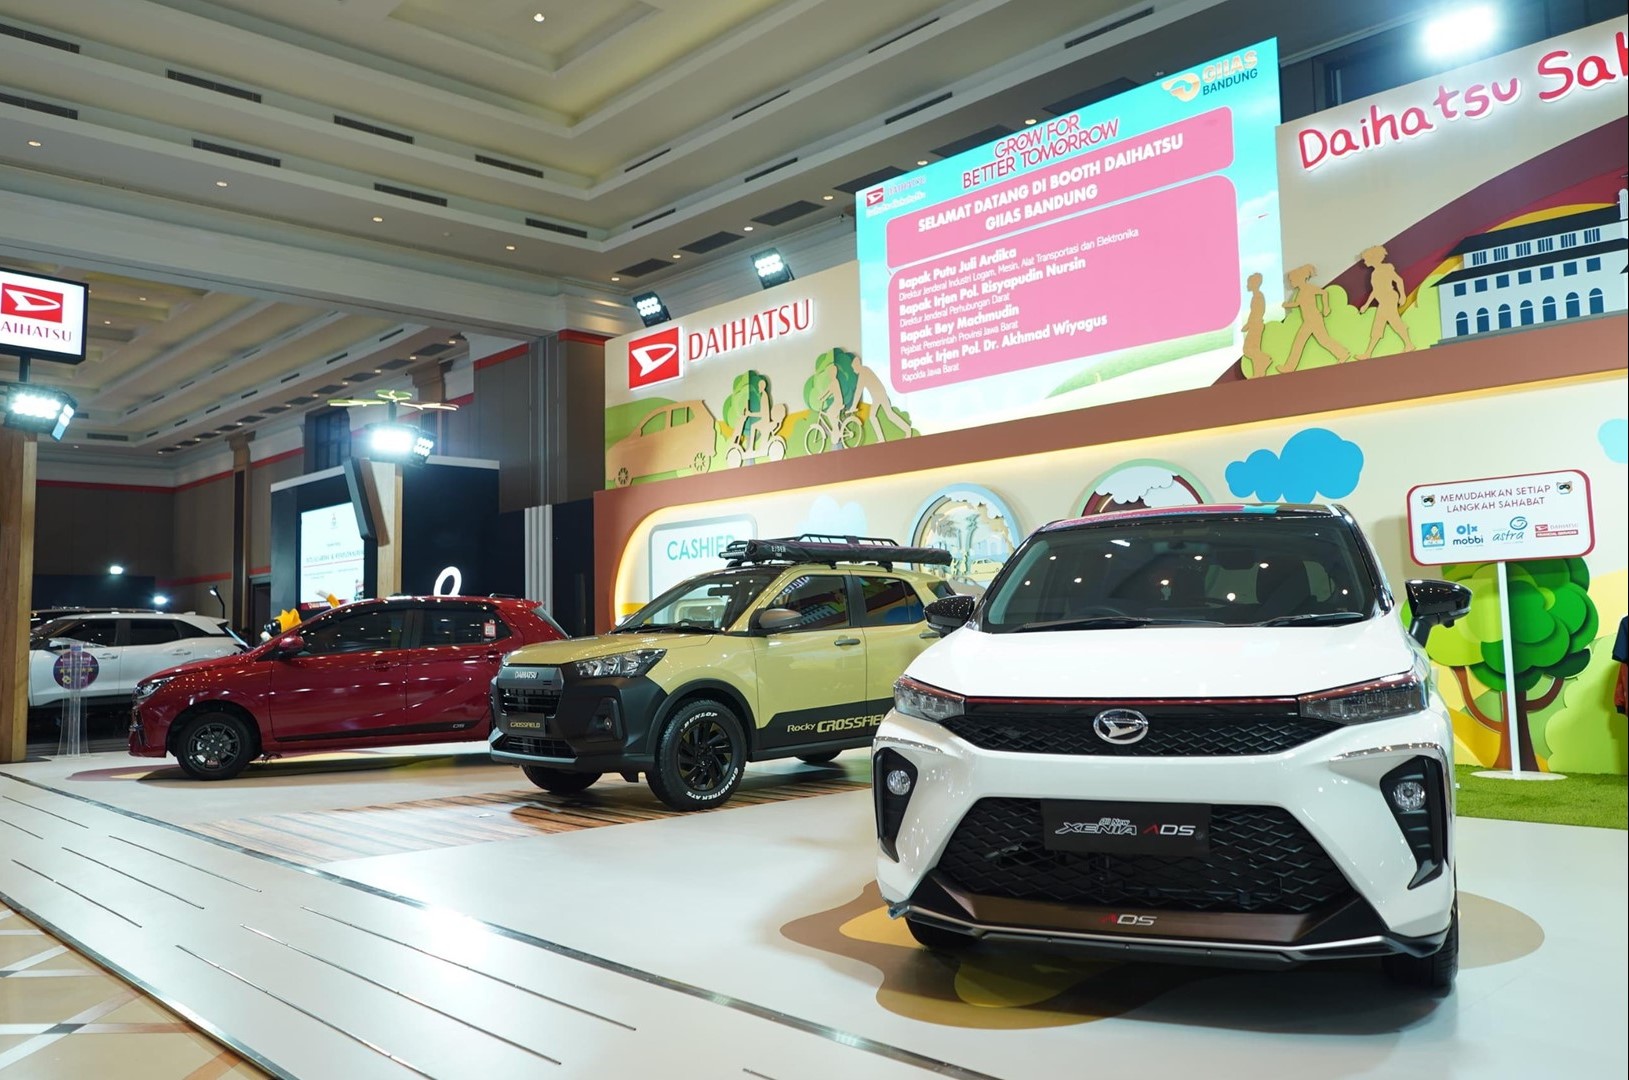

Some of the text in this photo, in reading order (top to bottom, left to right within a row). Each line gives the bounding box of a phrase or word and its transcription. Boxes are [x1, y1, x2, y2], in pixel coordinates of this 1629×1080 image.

[1202, 50, 1257, 83] GIIAS
[1203, 69, 1258, 95] BANDUNG
[995, 115, 1080, 158] GROW FOR
[1299, 78, 1518, 169] Daihatsu
[963, 119, 1118, 188] BETTER TOMORROW
[918, 204, 972, 232] SELAMAT
[974, 185, 1029, 214] DATANG
[1032, 178, 1046, 195] DI
[1051, 160, 1100, 190] BOOTH
[1104, 133, 1183, 172] DAIHATSU
[985, 183, 1098, 231] GIIAS BANDUNG
[899, 289, 922, 301] Direktur
[948, 275, 972, 287] Industri
[1036, 243, 1079, 263] Transportasi
[1081, 240, 1095, 251] dan
[1096, 228, 1139, 247] Elektronika
[899, 248, 1017, 290] Bapak Putu Juli Ardika
[899, 256, 1086, 316] Bapak Irjen Pol. Risyapudin Nursin
[0, 321, 72, 342] AIHATSU
[688, 299, 812, 361] DAIHATSU
[900, 304, 1019, 343] Bapak Bey Machmudin
[1000, 321, 1018, 332] Barat
[901, 315, 1107, 370] Bapak Irjen Pol. Dr. Akhmad Wiyagus
[943, 363, 960, 373] Barat
[1440, 484, 1551, 502] MEMUDAHKAN SETIAP
[1446, 496, 1545, 513] LANGKAH SAHABAT
[1453, 535, 1484, 545] mobbi
[1492, 530, 1524, 541] astra
[684, 712, 718, 727] DUNLOP
[787, 722, 816, 732] Rocky
[1055, 822, 1196, 836] XENIA ADS
[1112, 818, 1130, 826] New
